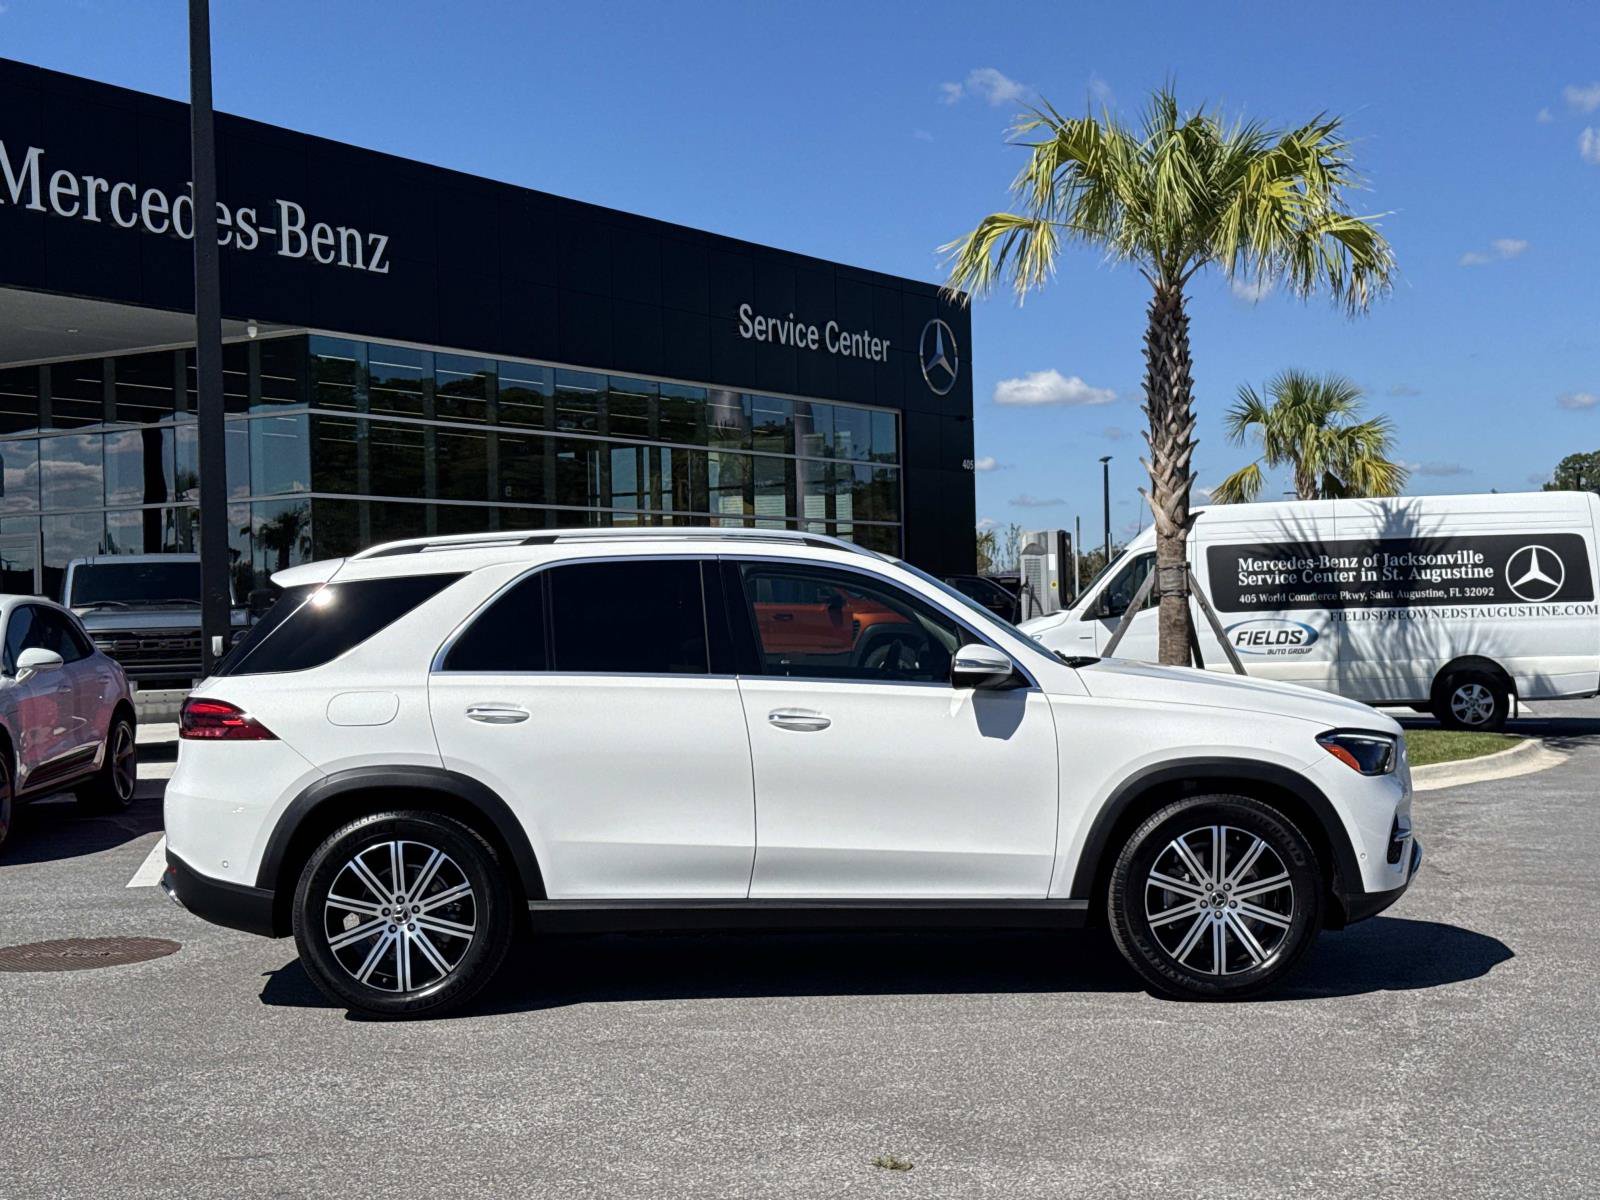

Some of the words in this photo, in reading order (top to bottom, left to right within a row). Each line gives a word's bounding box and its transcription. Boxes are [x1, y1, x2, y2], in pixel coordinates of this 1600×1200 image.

[738, 303, 819, 350] Service
[825, 320, 891, 362] Center
[962, 459, 974, 470] 405
[1238, 555, 1359, 572] Mercedes-Benz
[1363, 554, 1380, 568] of
[1384, 550, 1484, 567] Jacksonville
[1238, 570, 1298, 586] Service
[1302, 569, 1356, 584] Center
[1360, 568, 1378, 582] in
[1382, 567, 1404, 581] St.
[1409, 565, 1494, 582] Augustine
[1239, 593, 1257, 604] 405
[1259, 593, 1286, 603] World
[1288, 592, 1338, 602] Commerce
[1340, 591, 1368, 601] Pkwy,
[1369, 590, 1394, 600] Saint
[1397, 588, 1448, 600] Augustine,
[1450, 588, 1463, 598] FL
[1464, 587, 1495, 597] 32092
[1330, 605, 1599, 622] FIELDSPREOWNEDSTAUGUSTINE.COM
[1235, 630, 1303, 646] FIELDS
